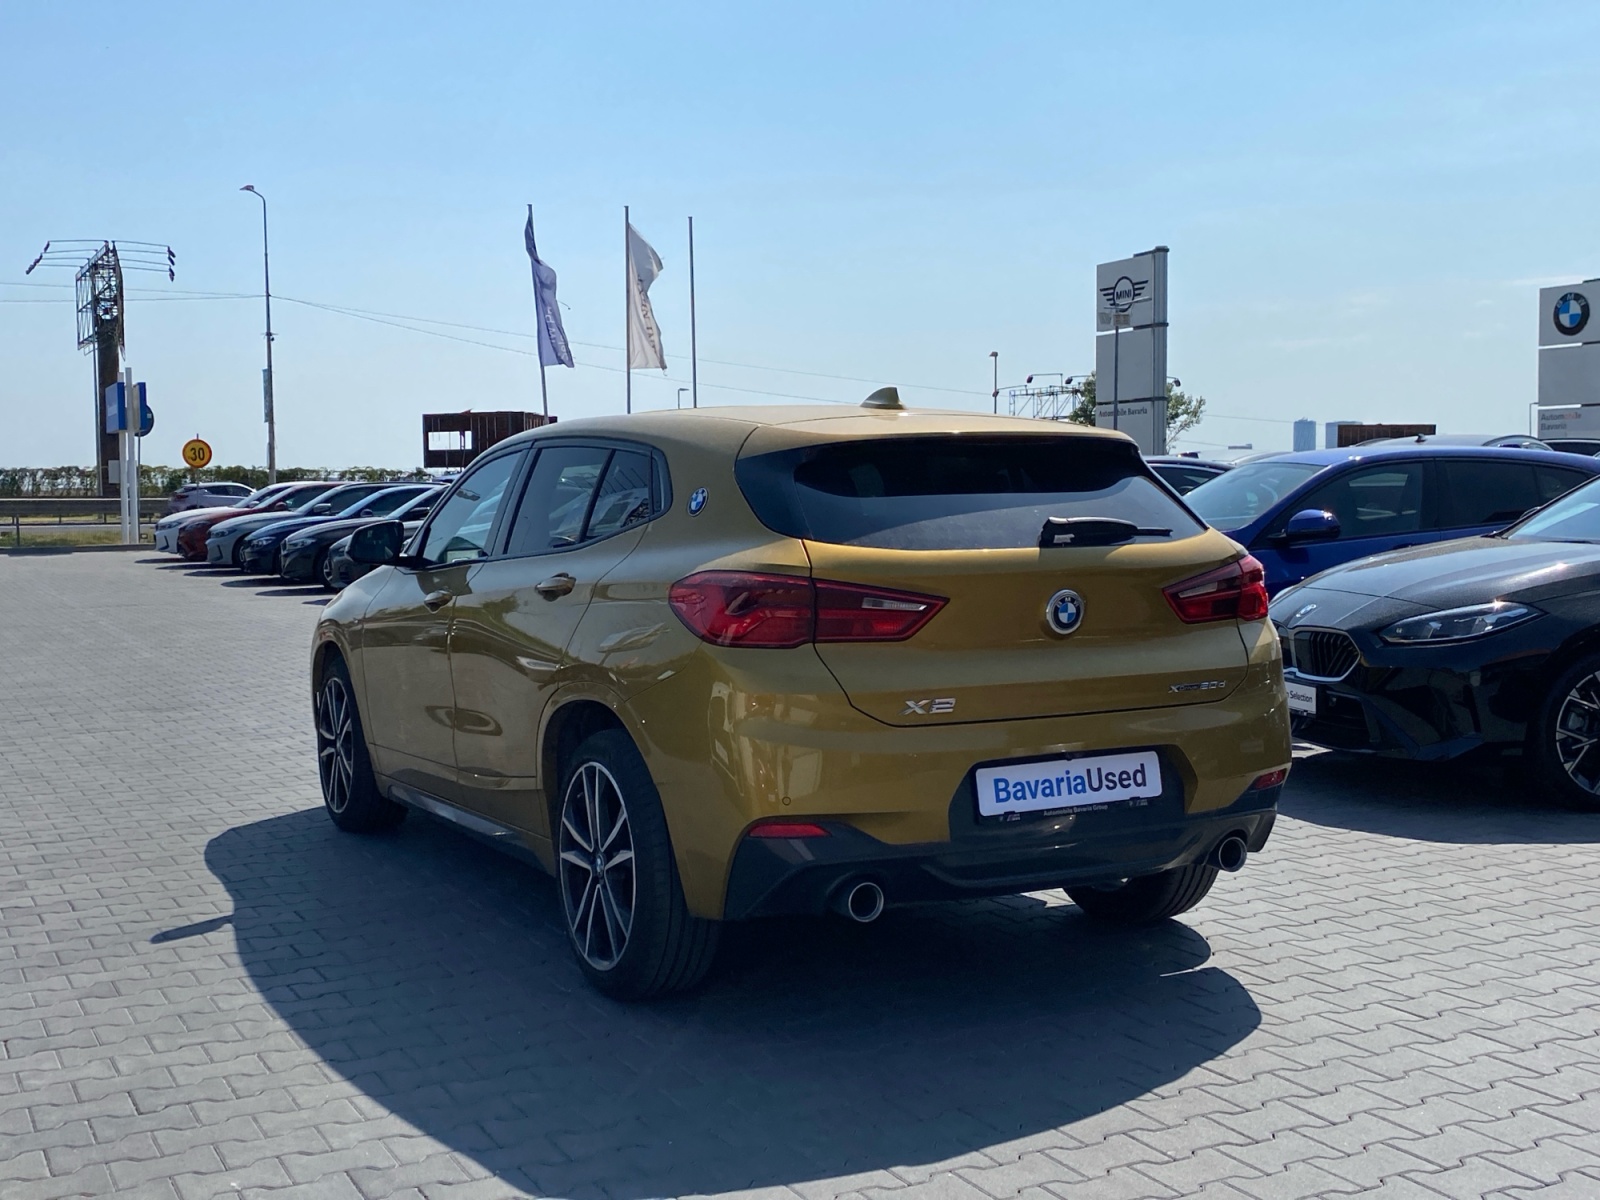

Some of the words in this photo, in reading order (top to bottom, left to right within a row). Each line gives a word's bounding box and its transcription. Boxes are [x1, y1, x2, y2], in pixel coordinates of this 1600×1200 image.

[1115, 289, 1132, 301] MINI
[1556, 293, 1587, 308] BMW
[1099, 408, 1127, 417] Autombile
[1127, 406, 1148, 415] Bavaria
[190, 447, 205, 462] 30
[1290, 690, 1313, 703] Selection
[899, 698, 956, 715] X2
[993, 763, 1147, 803] BavariaUsed
[1043, 807, 1073, 816] Automobile
[1073, 804, 1093, 813] Bavaria
[1093, 802, 1109, 810] Group
